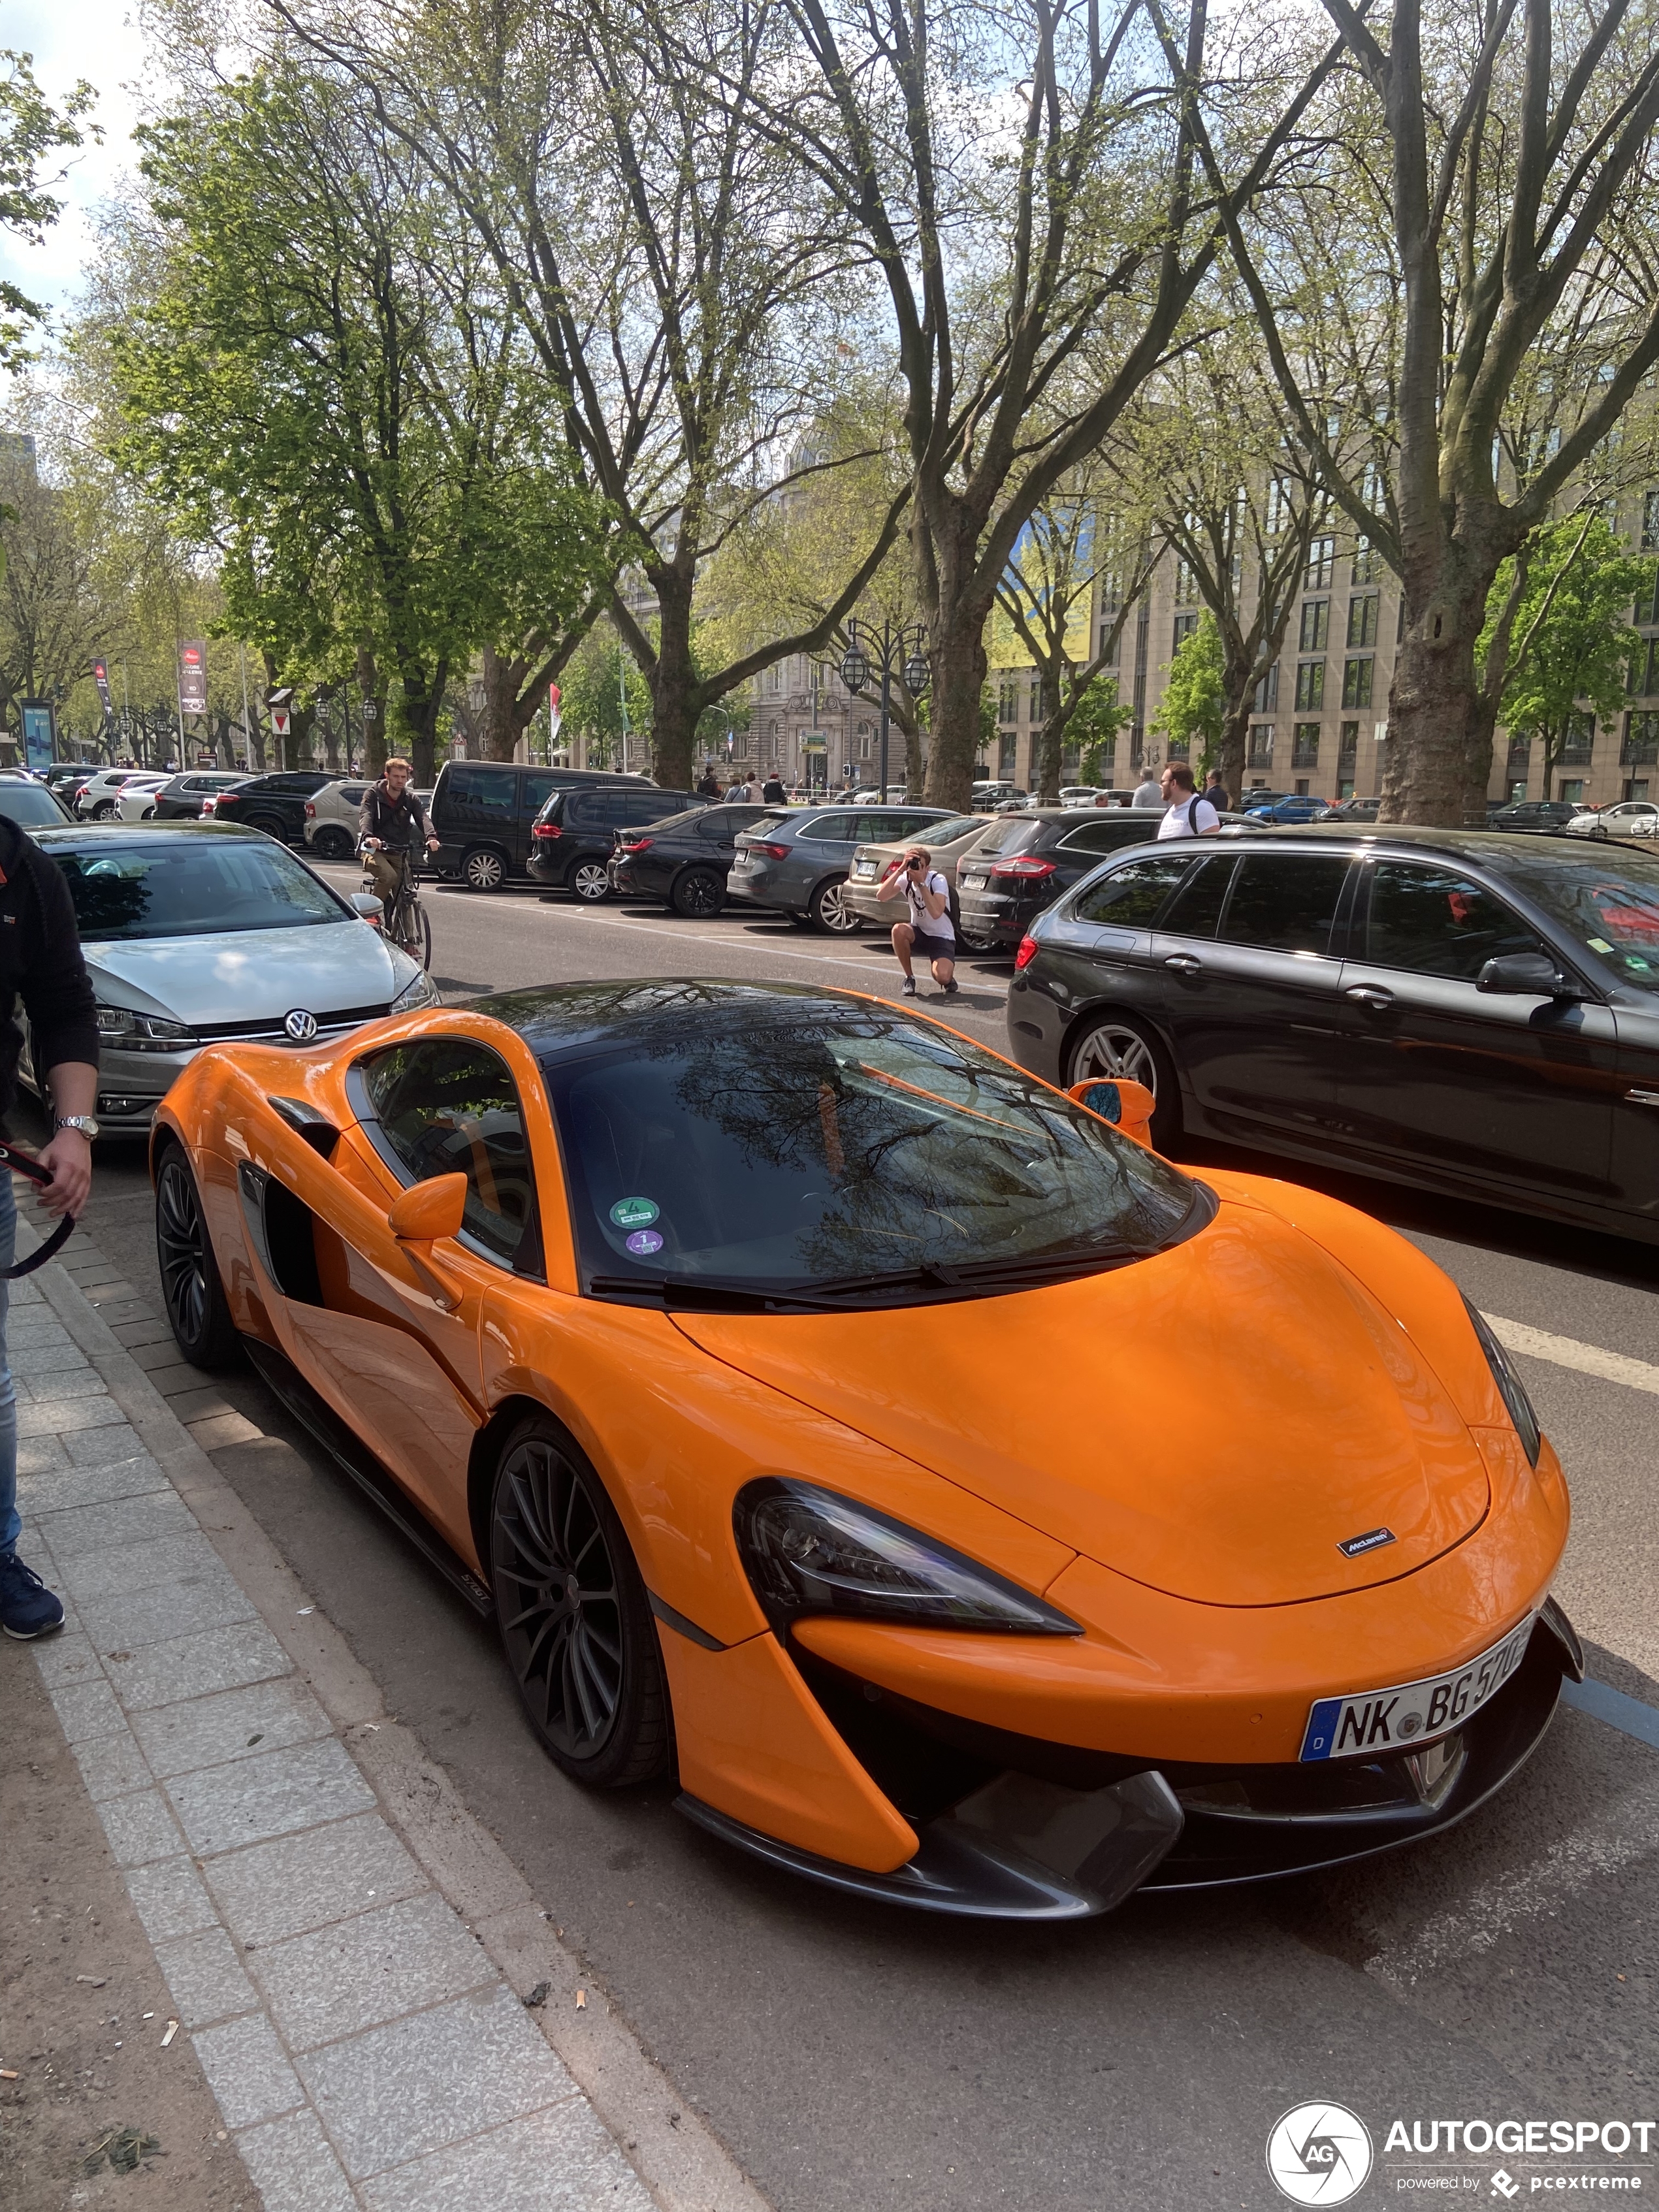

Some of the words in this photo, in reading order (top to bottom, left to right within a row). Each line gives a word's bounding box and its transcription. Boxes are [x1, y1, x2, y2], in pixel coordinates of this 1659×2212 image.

[628, 1202, 639, 1212] 4
[1349, 1533, 1387, 1552] McLaren
[1313, 1737, 1325, 1750] D
[1338, 1696, 1400, 1750] NK
[1425, 1671, 1472, 1732] BG
[1474, 1634, 1521, 1705] 570
